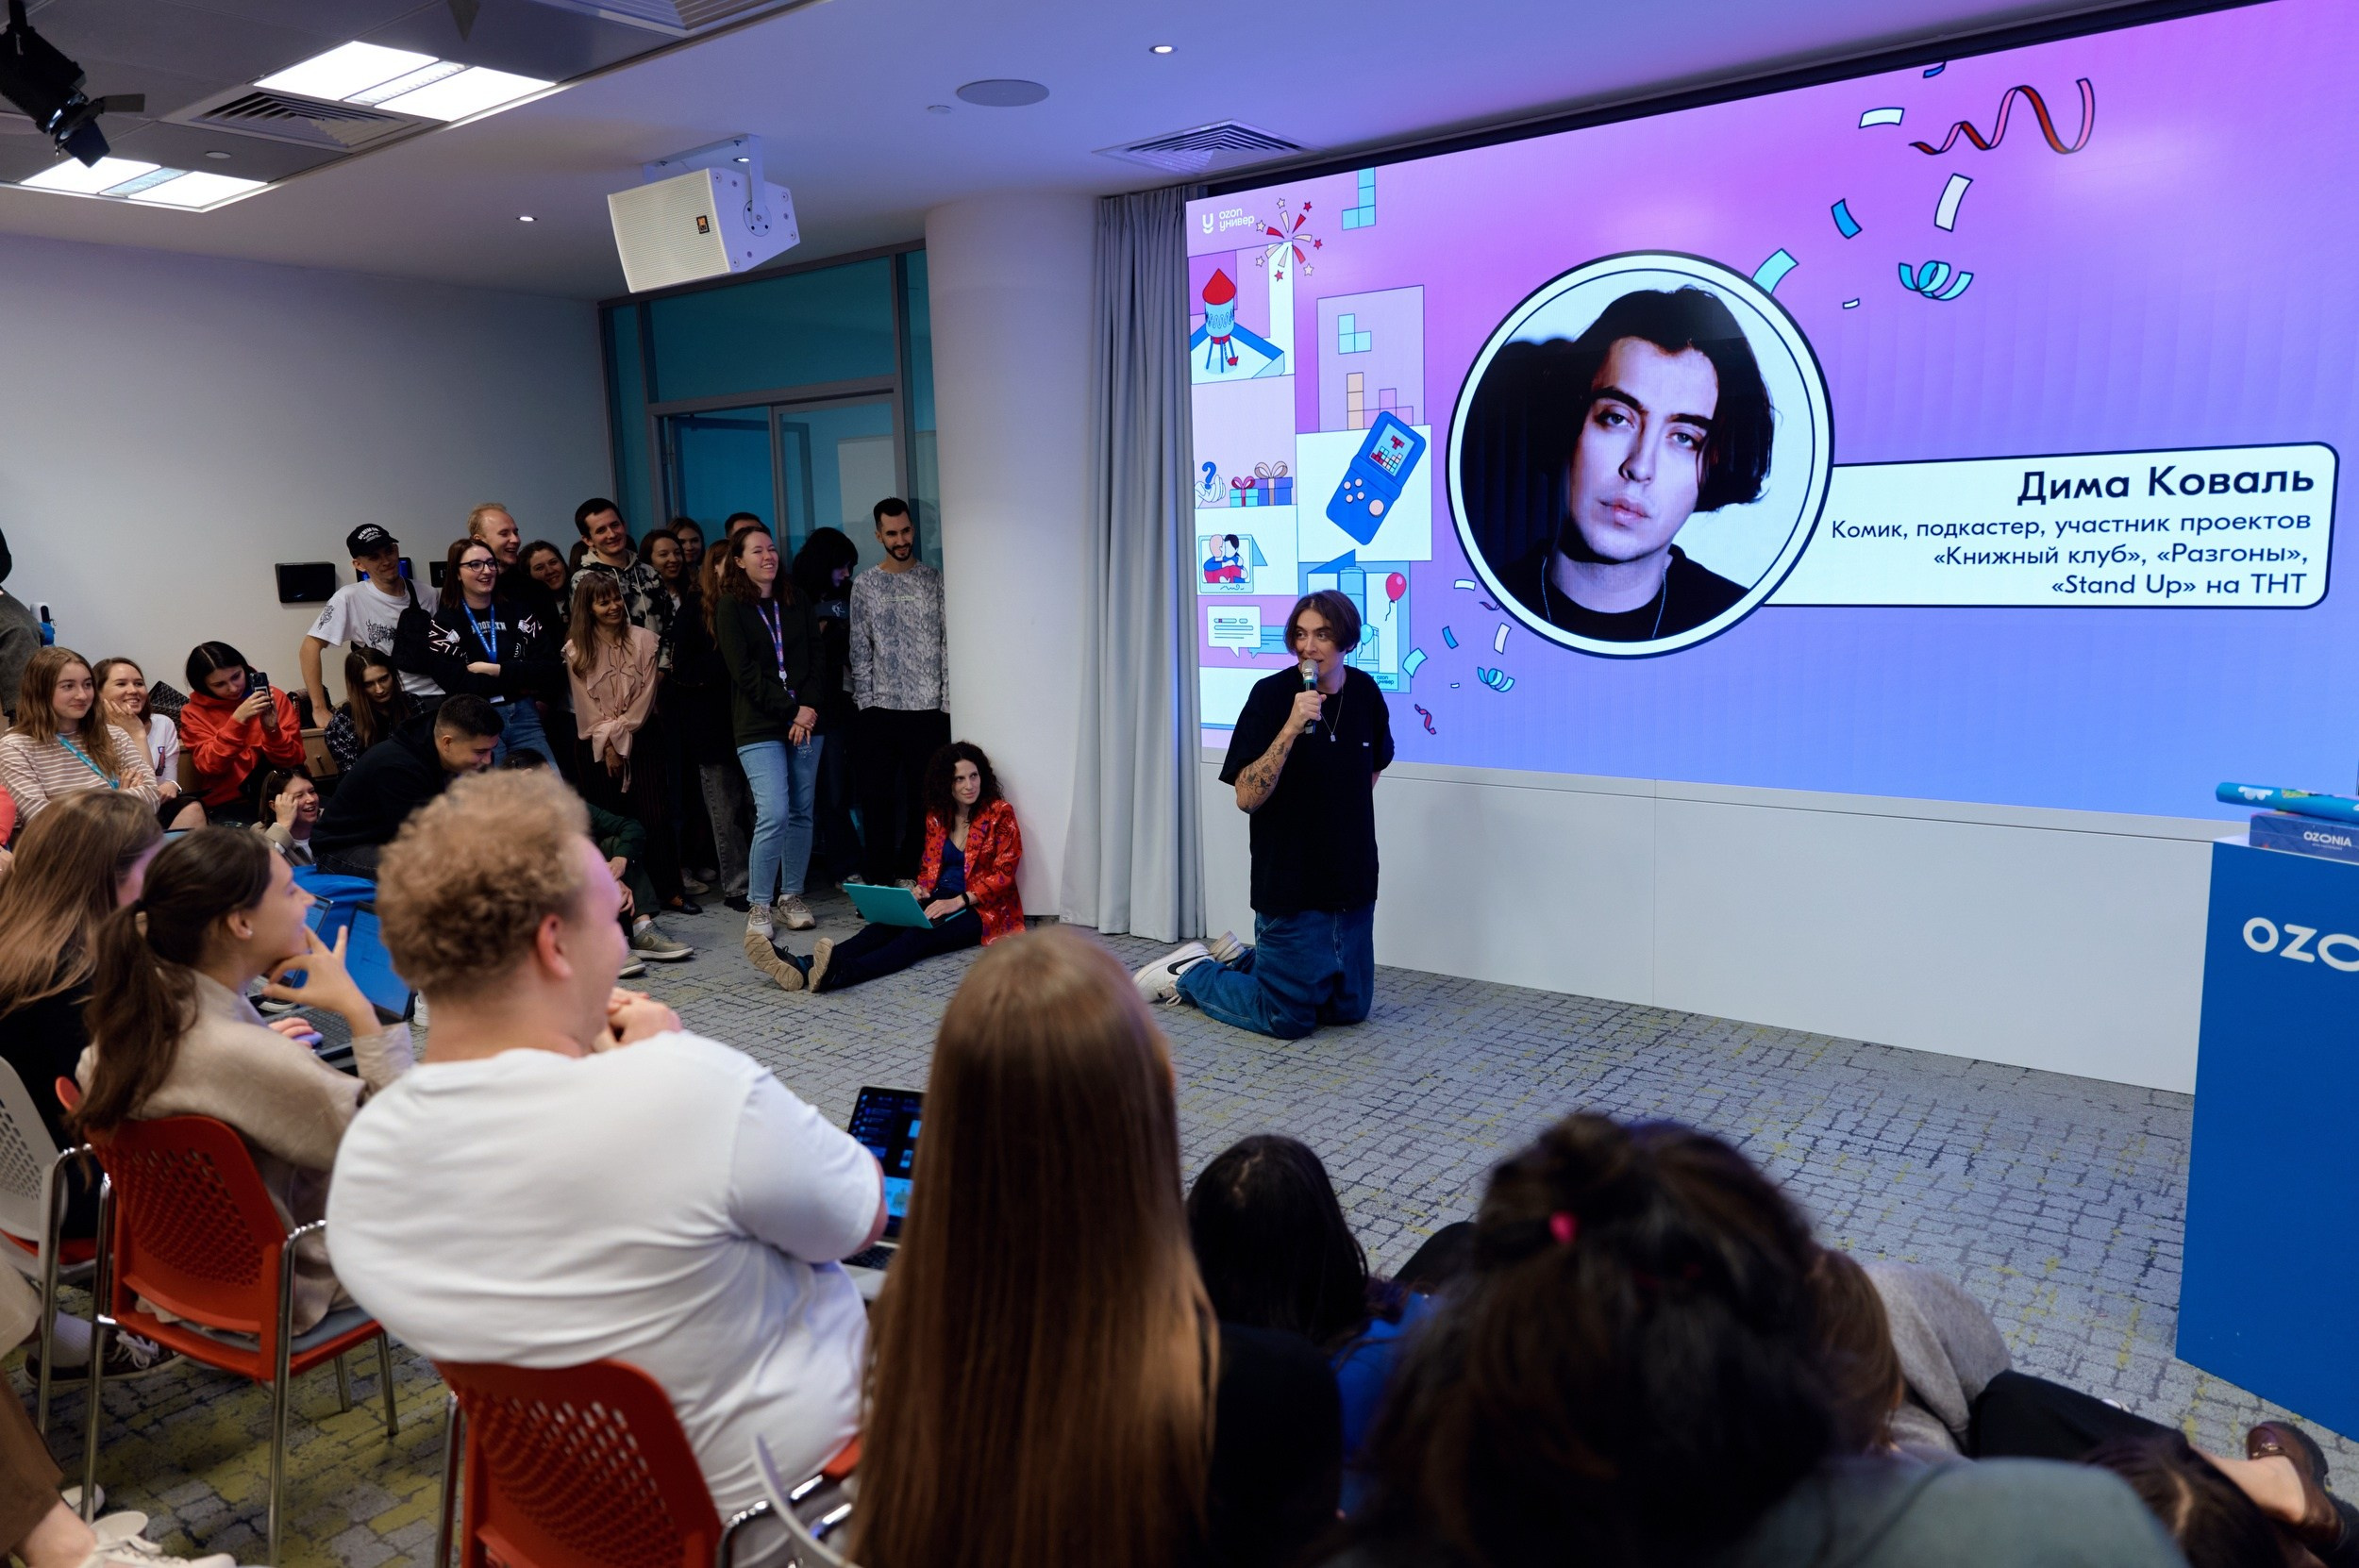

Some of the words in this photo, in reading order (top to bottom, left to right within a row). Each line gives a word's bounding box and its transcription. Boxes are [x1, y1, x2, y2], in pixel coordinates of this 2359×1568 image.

[1218, 208, 1243, 220] ozon
[1219, 215, 1255, 232] универ
[2016, 471, 2130, 507] Дима
[2149, 465, 2314, 496] Коваль
[1832, 520, 1908, 540] Комик,
[1916, 521, 2046, 539] подкастер,
[2054, 518, 2170, 539] участник
[2180, 514, 2311, 536] проектов
[1933, 545, 2059, 565] «Книжный
[2068, 543, 2147, 568] клуб»,
[2156, 542, 2308, 565] «Разгоны»,
[2051, 574, 2135, 594] «Stand
[2146, 574, 2197, 598] Up»
[2206, 579, 2240, 594] на
[2250, 573, 2308, 594] ТНТ
[2303, 830, 2352, 847] OZONIA
